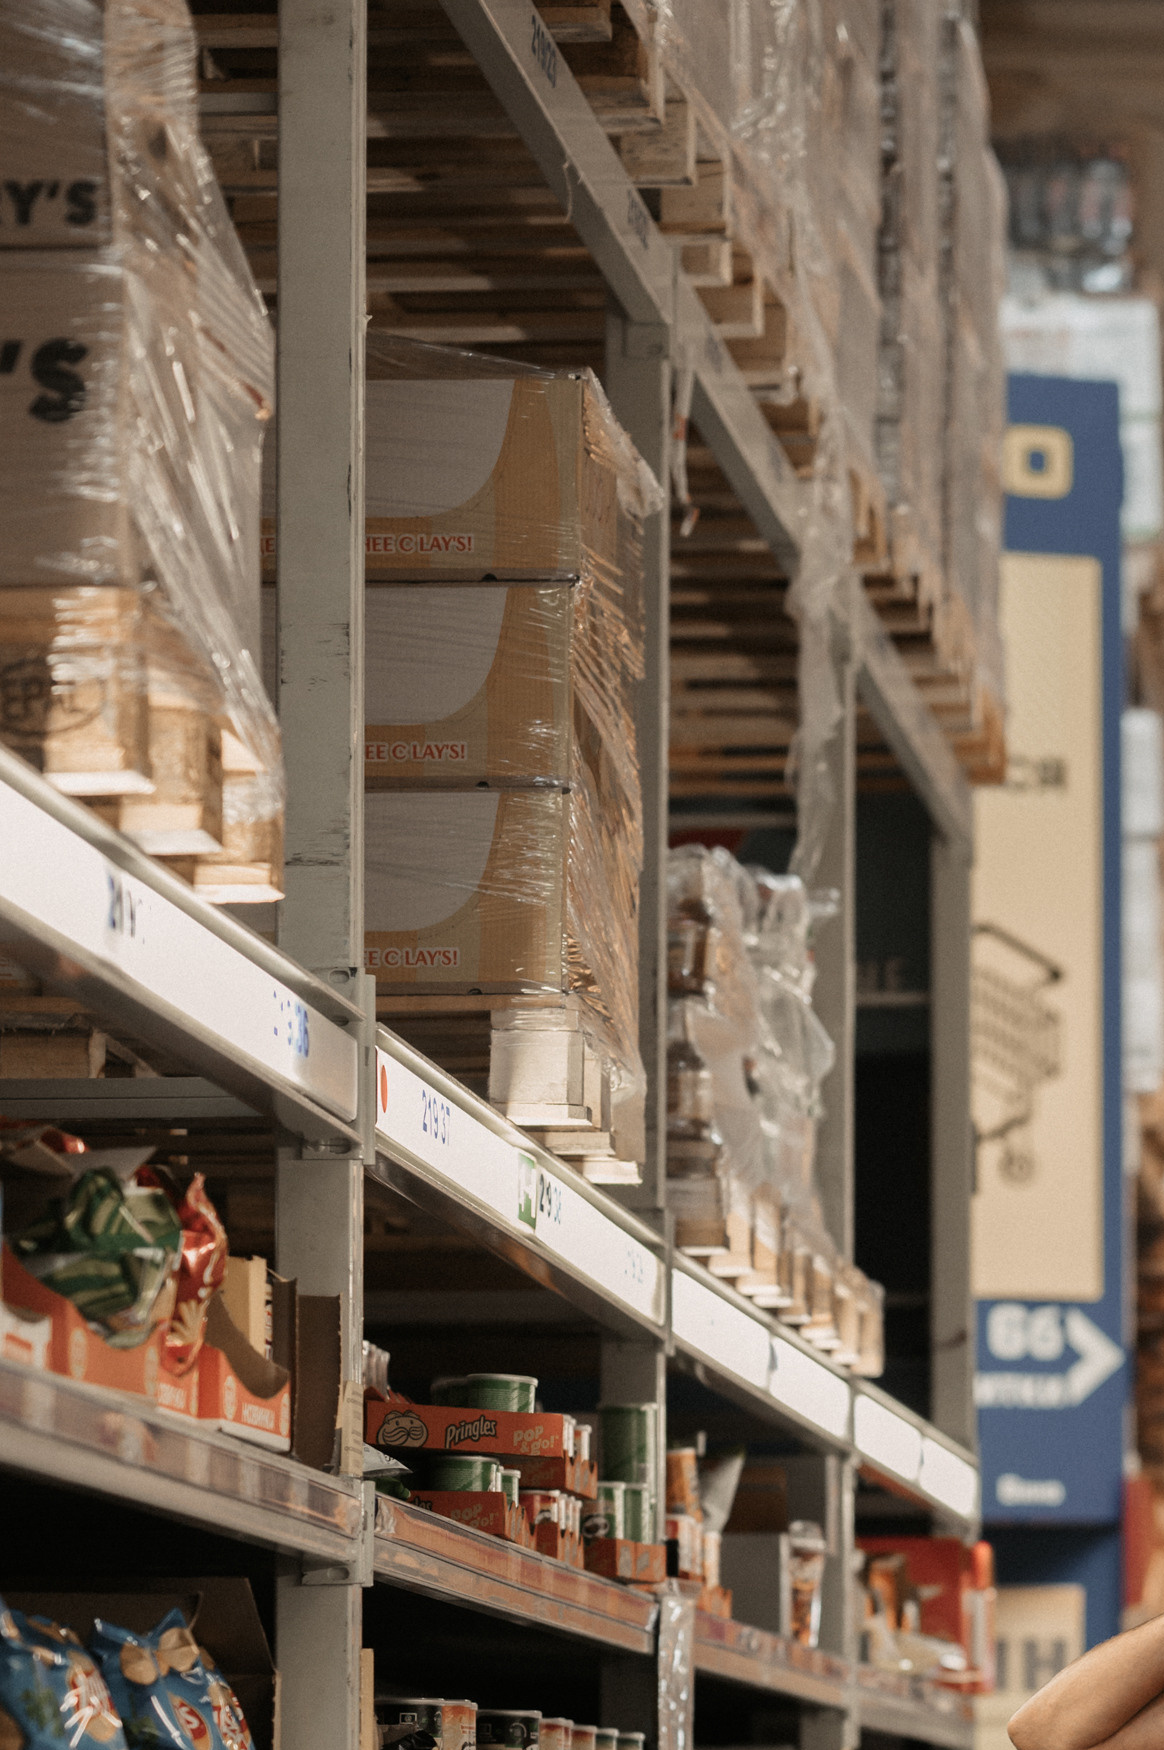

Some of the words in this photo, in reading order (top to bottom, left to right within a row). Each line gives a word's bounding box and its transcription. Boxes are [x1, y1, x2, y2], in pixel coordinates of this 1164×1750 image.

[419, 535, 472, 553] LAY'S!
[412, 743, 466, 760] LAY'S!
[405, 950, 458, 966] LAY'S!
[445, 1414, 498, 1450] Pringles
